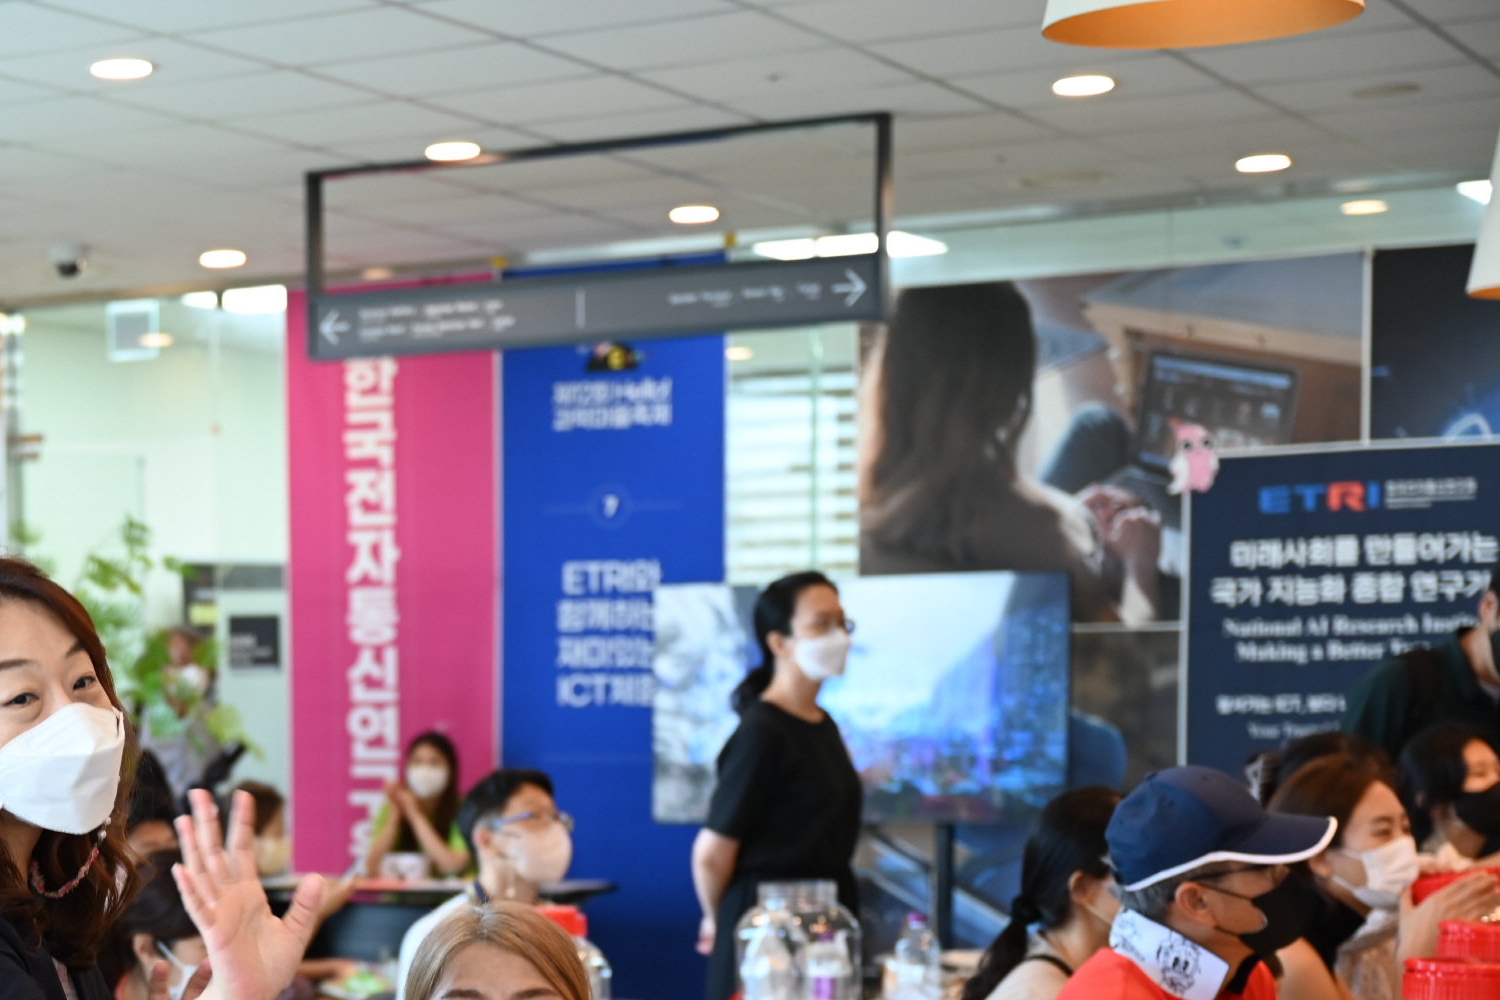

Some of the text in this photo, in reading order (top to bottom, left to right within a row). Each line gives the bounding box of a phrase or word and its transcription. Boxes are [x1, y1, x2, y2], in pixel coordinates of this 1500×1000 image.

[1259, 481, 1381, 513] ETRI
[1230, 532, 1498, 568] 미래사회를 만들어가는
[1209, 575, 1263, 608] 국가
[1266, 573, 1347, 606] 지능화
[1410, 568, 1493, 602] 연구기
[1222, 616, 1303, 638] National
[1305, 614, 1330, 637] AI
[1332, 613, 1419, 637] Research
[1234, 641, 1310, 666] Making
[1310, 643, 1325, 662] a
[1326, 639, 1386, 662] Better
